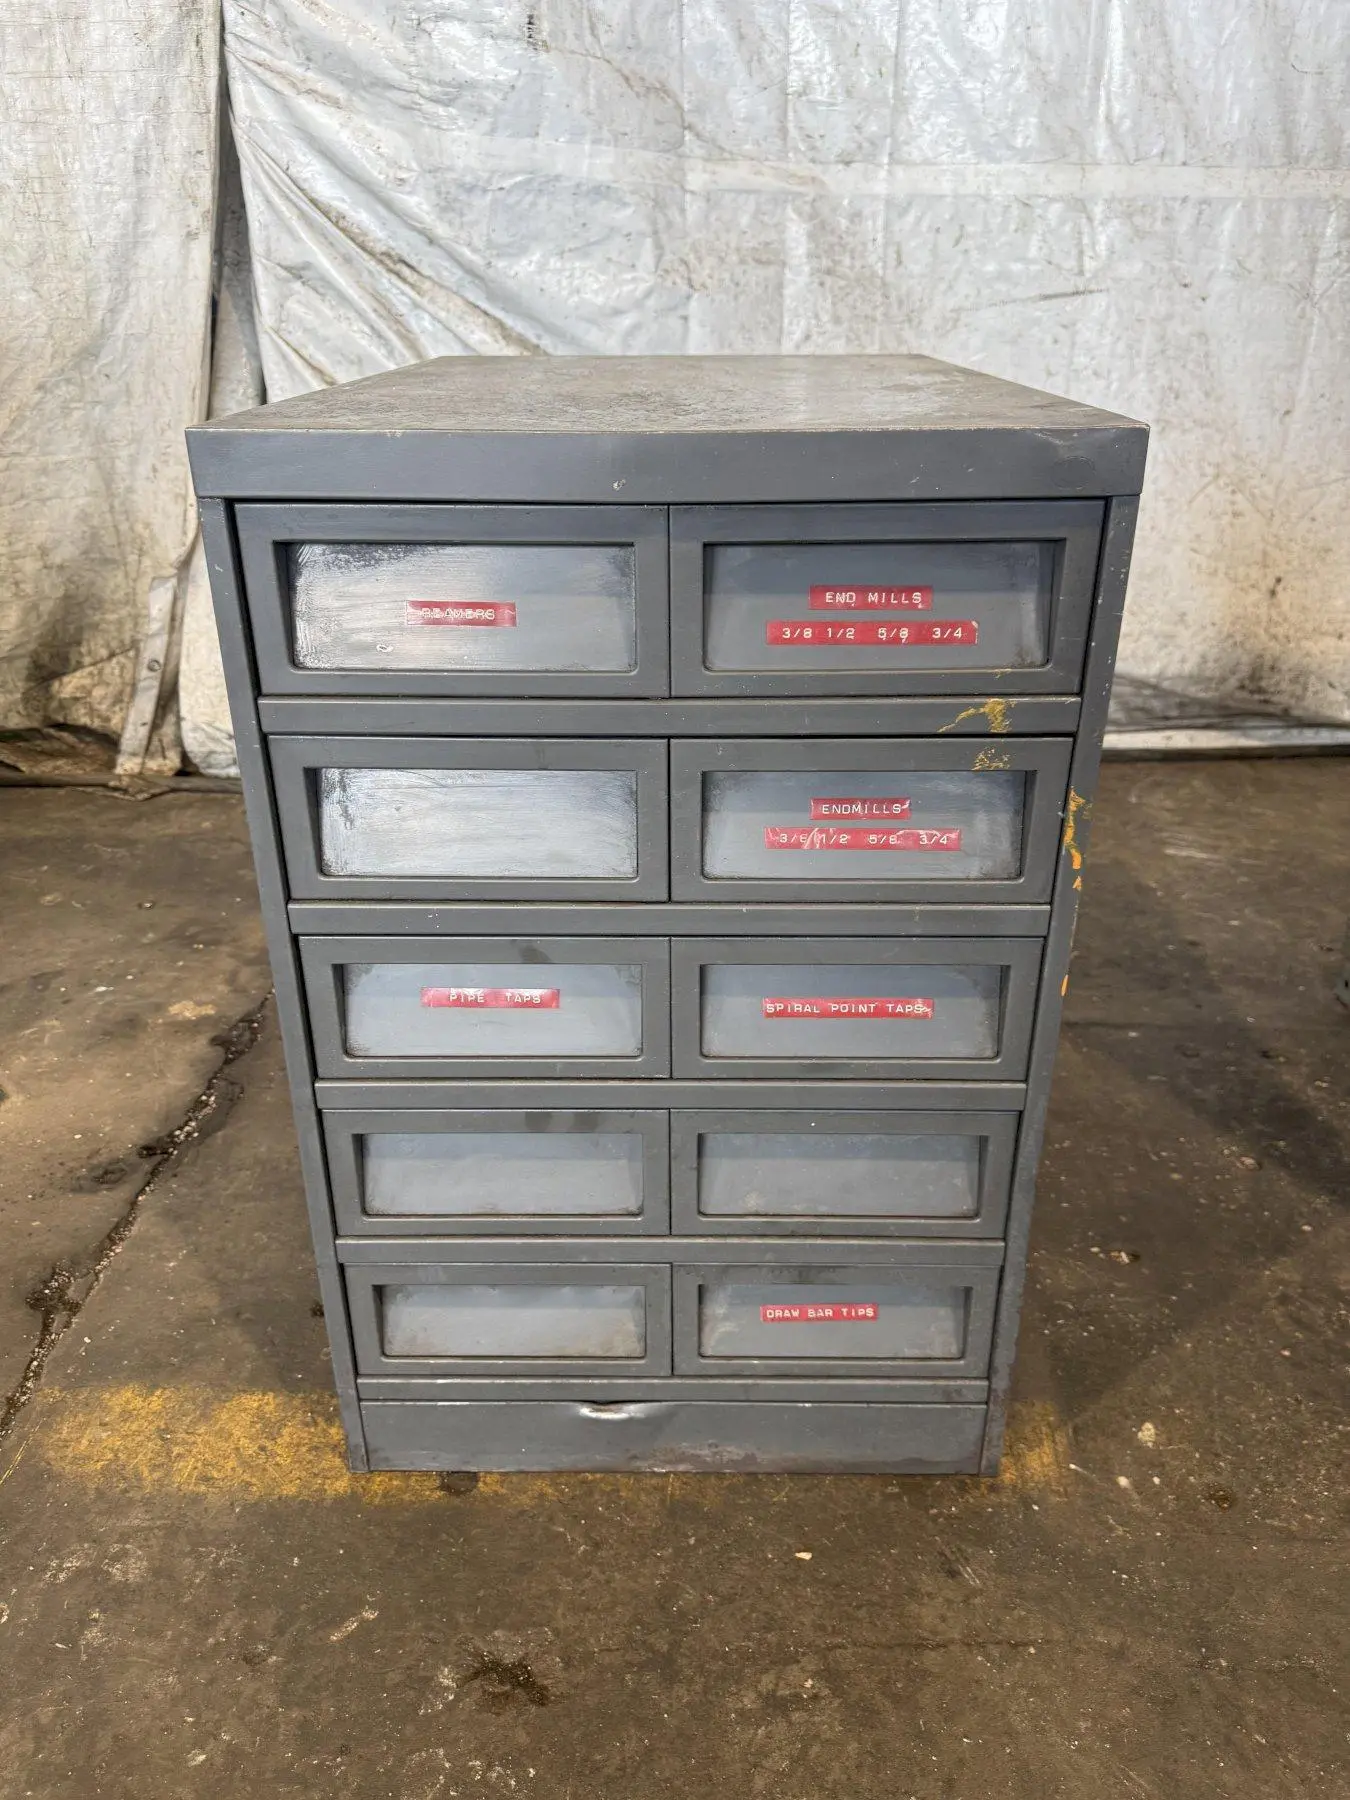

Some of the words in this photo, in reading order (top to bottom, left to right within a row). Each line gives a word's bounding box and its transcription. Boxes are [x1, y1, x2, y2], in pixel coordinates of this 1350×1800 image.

[825, 591, 856, 604] END
[868, 591, 922, 604] MILLS
[782, 627, 812, 639] 3/8
[826, 627, 855, 639] 1/2
[877, 627, 909, 640] 5/8
[931, 627, 963, 639] 3/4
[822, 803, 902, 814] ENDMILLS
[821, 833, 849, 844] 1/2
[868, 833, 898, 844] 5/8
[919, 833, 948, 845] 3/4
[449, 993, 485, 1003] PIPE
[505, 992, 541, 1004] TAPS
[765, 1003, 821, 1013] SPIRAL
[831, 1003, 876, 1013] POINT
[886, 1003, 922, 1014] TAPS
[766, 1309, 800, 1318] DRAW
[808, 1308, 833, 1318] BAR
[841, 1307, 874, 1318] TIPS
